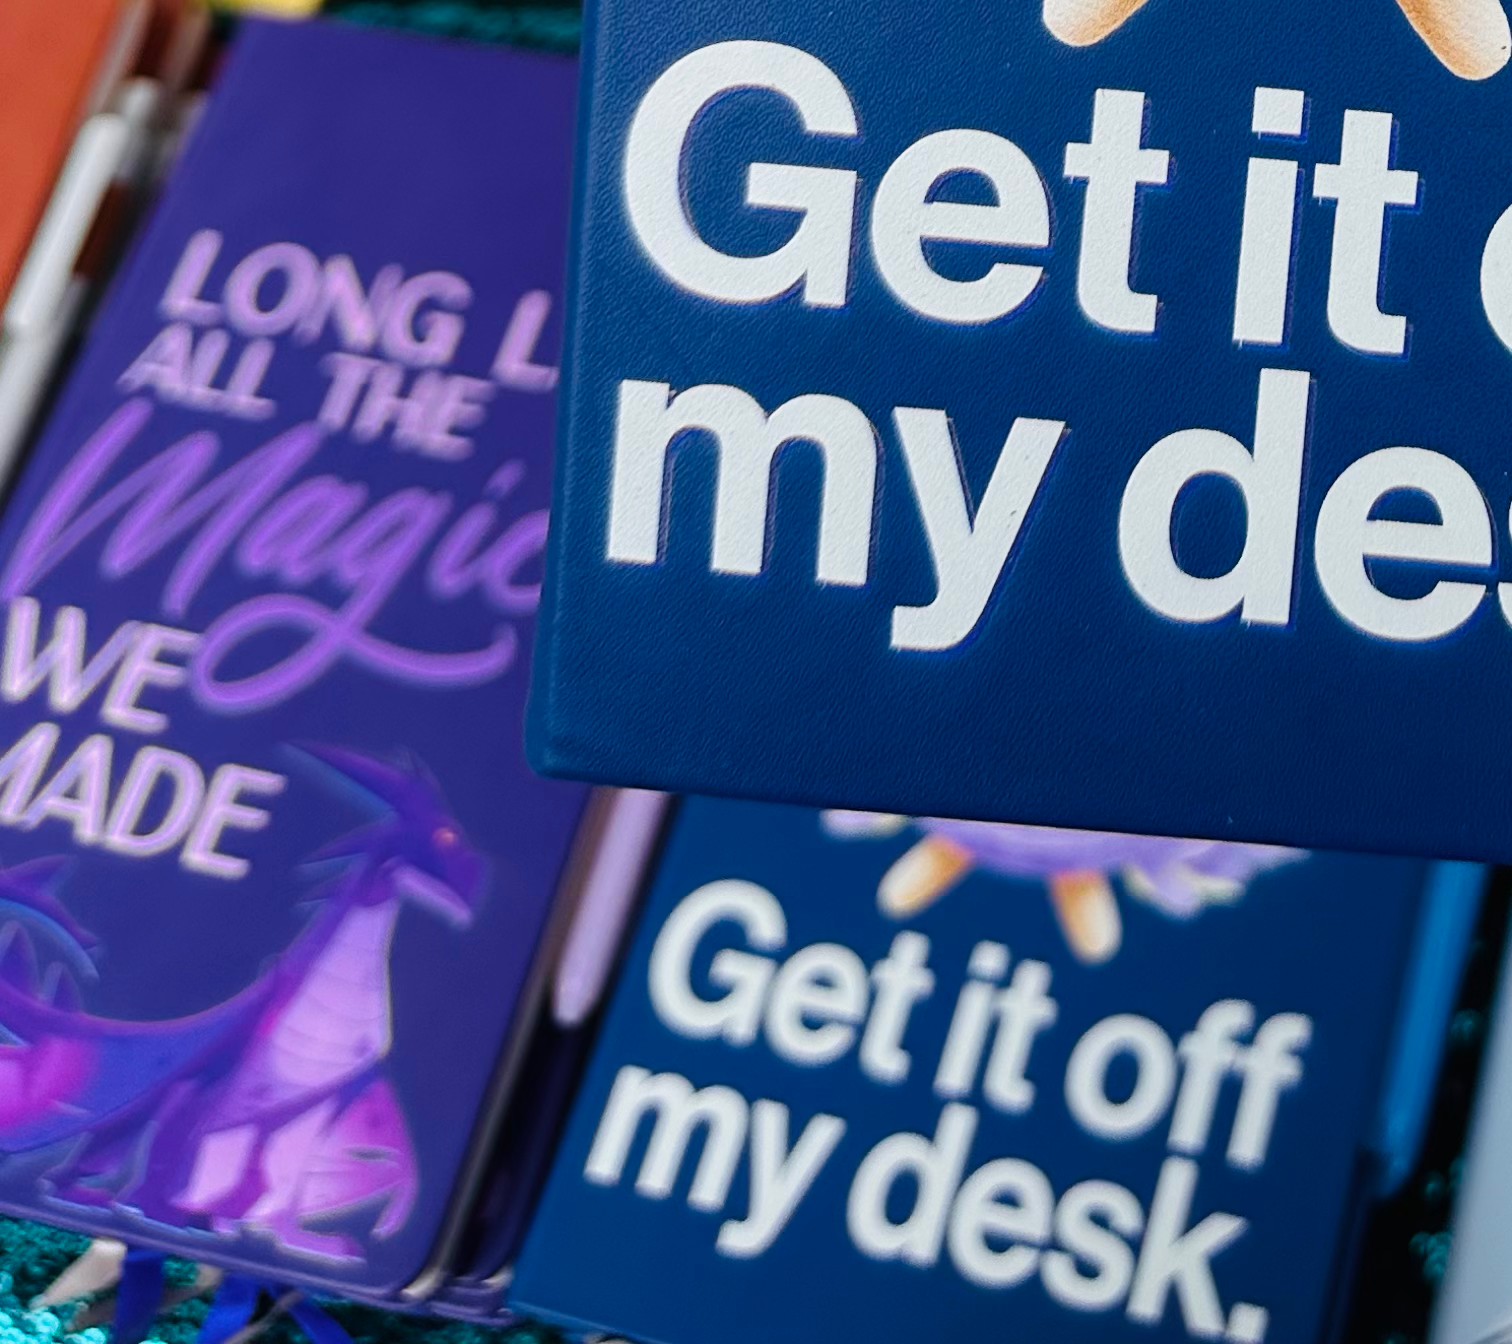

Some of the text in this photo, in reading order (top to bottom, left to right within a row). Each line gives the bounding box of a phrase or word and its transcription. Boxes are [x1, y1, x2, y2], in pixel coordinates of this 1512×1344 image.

[159, 229, 473, 367] LONG
[623, 40, 1169, 337] Get
[1232, 87, 1418, 355] it
[116, 322, 497, 460] ALL THE
[605, 379, 1066, 651] my
[2, 595, 205, 733] WE
[648, 879, 1313, 1170] Get it off
[583, 1065, 1269, 1344] my desk.
